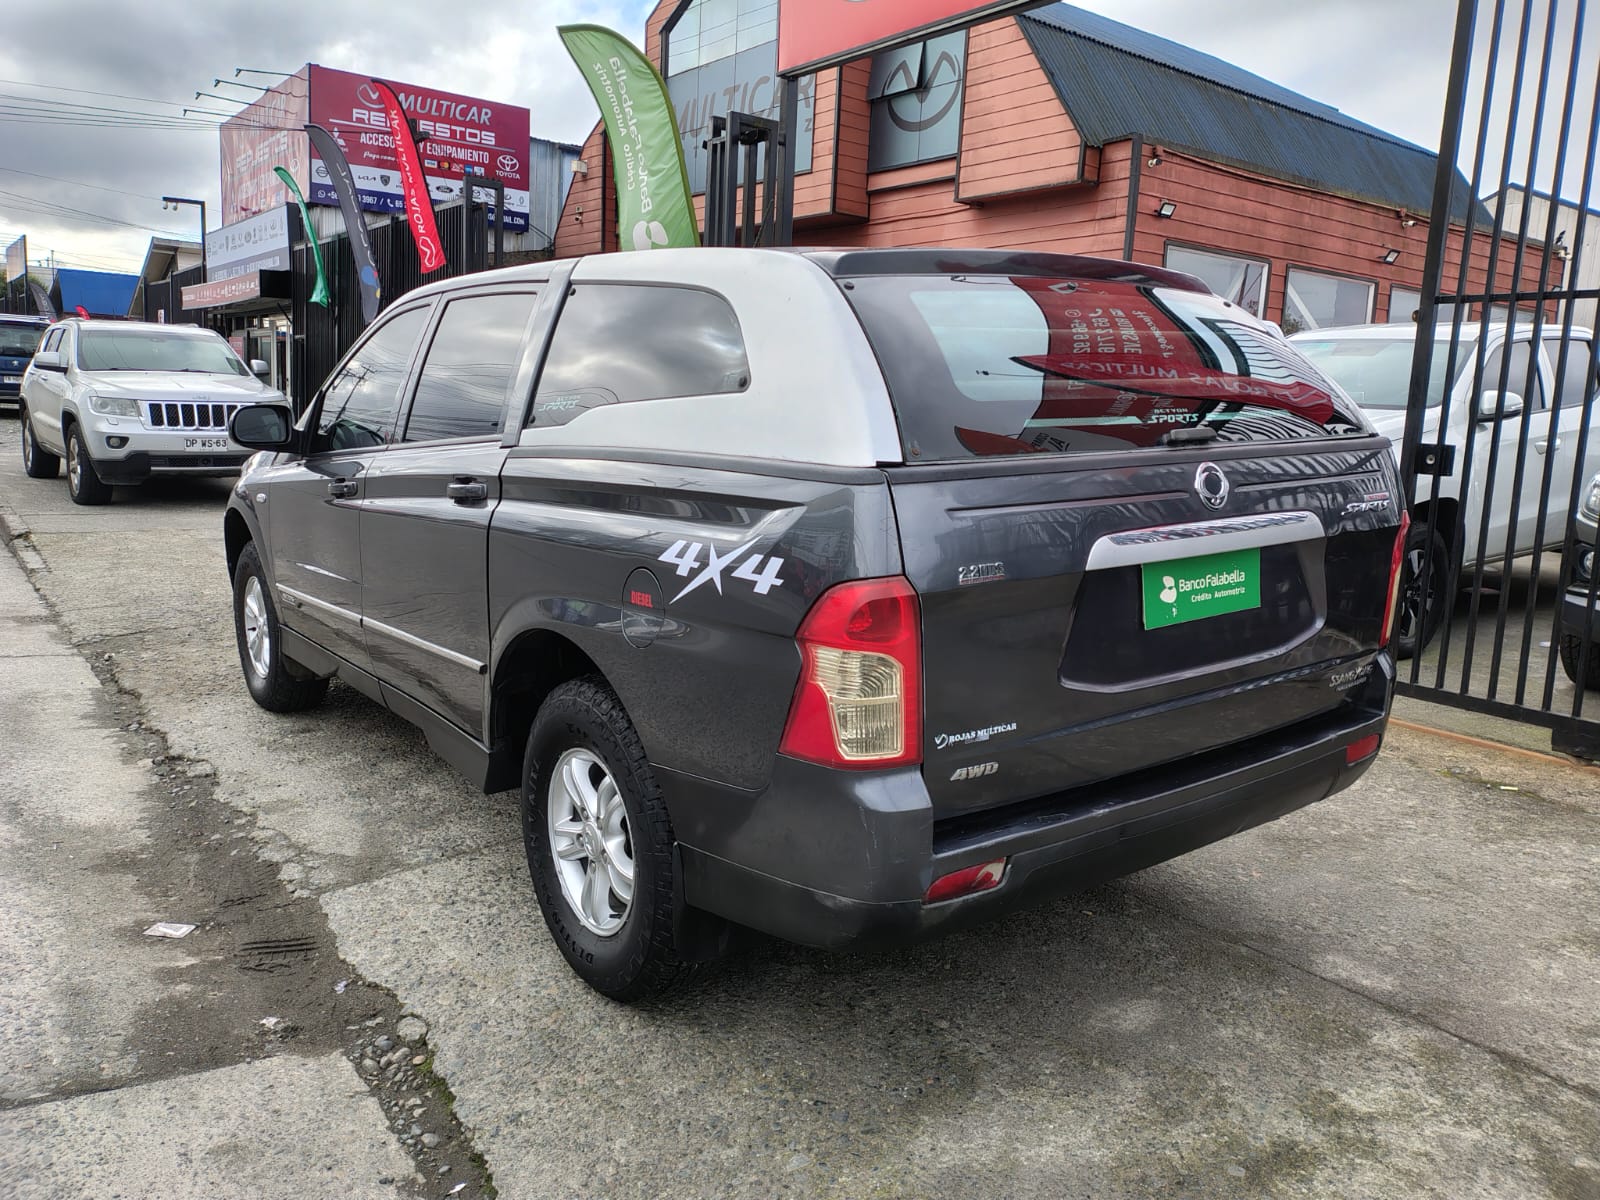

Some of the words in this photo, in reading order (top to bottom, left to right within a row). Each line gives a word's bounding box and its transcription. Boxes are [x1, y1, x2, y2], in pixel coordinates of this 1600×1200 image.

[398, 92, 492, 125] MULTICAR
[427, 142, 490, 164] EQUIPAMIENTO
[495, 170, 520, 179] TOYOTA
[1147, 413, 1200, 424] SPORTS
[185, 439, 197, 447] DP
[630, 590, 653, 609] DIESEL
[1214, 586, 1246, 598] Automotriz
[949, 730, 976, 743] ROJAS
[976, 722, 1017, 740] MULTICAR
[949, 761, 999, 781] 4WD
